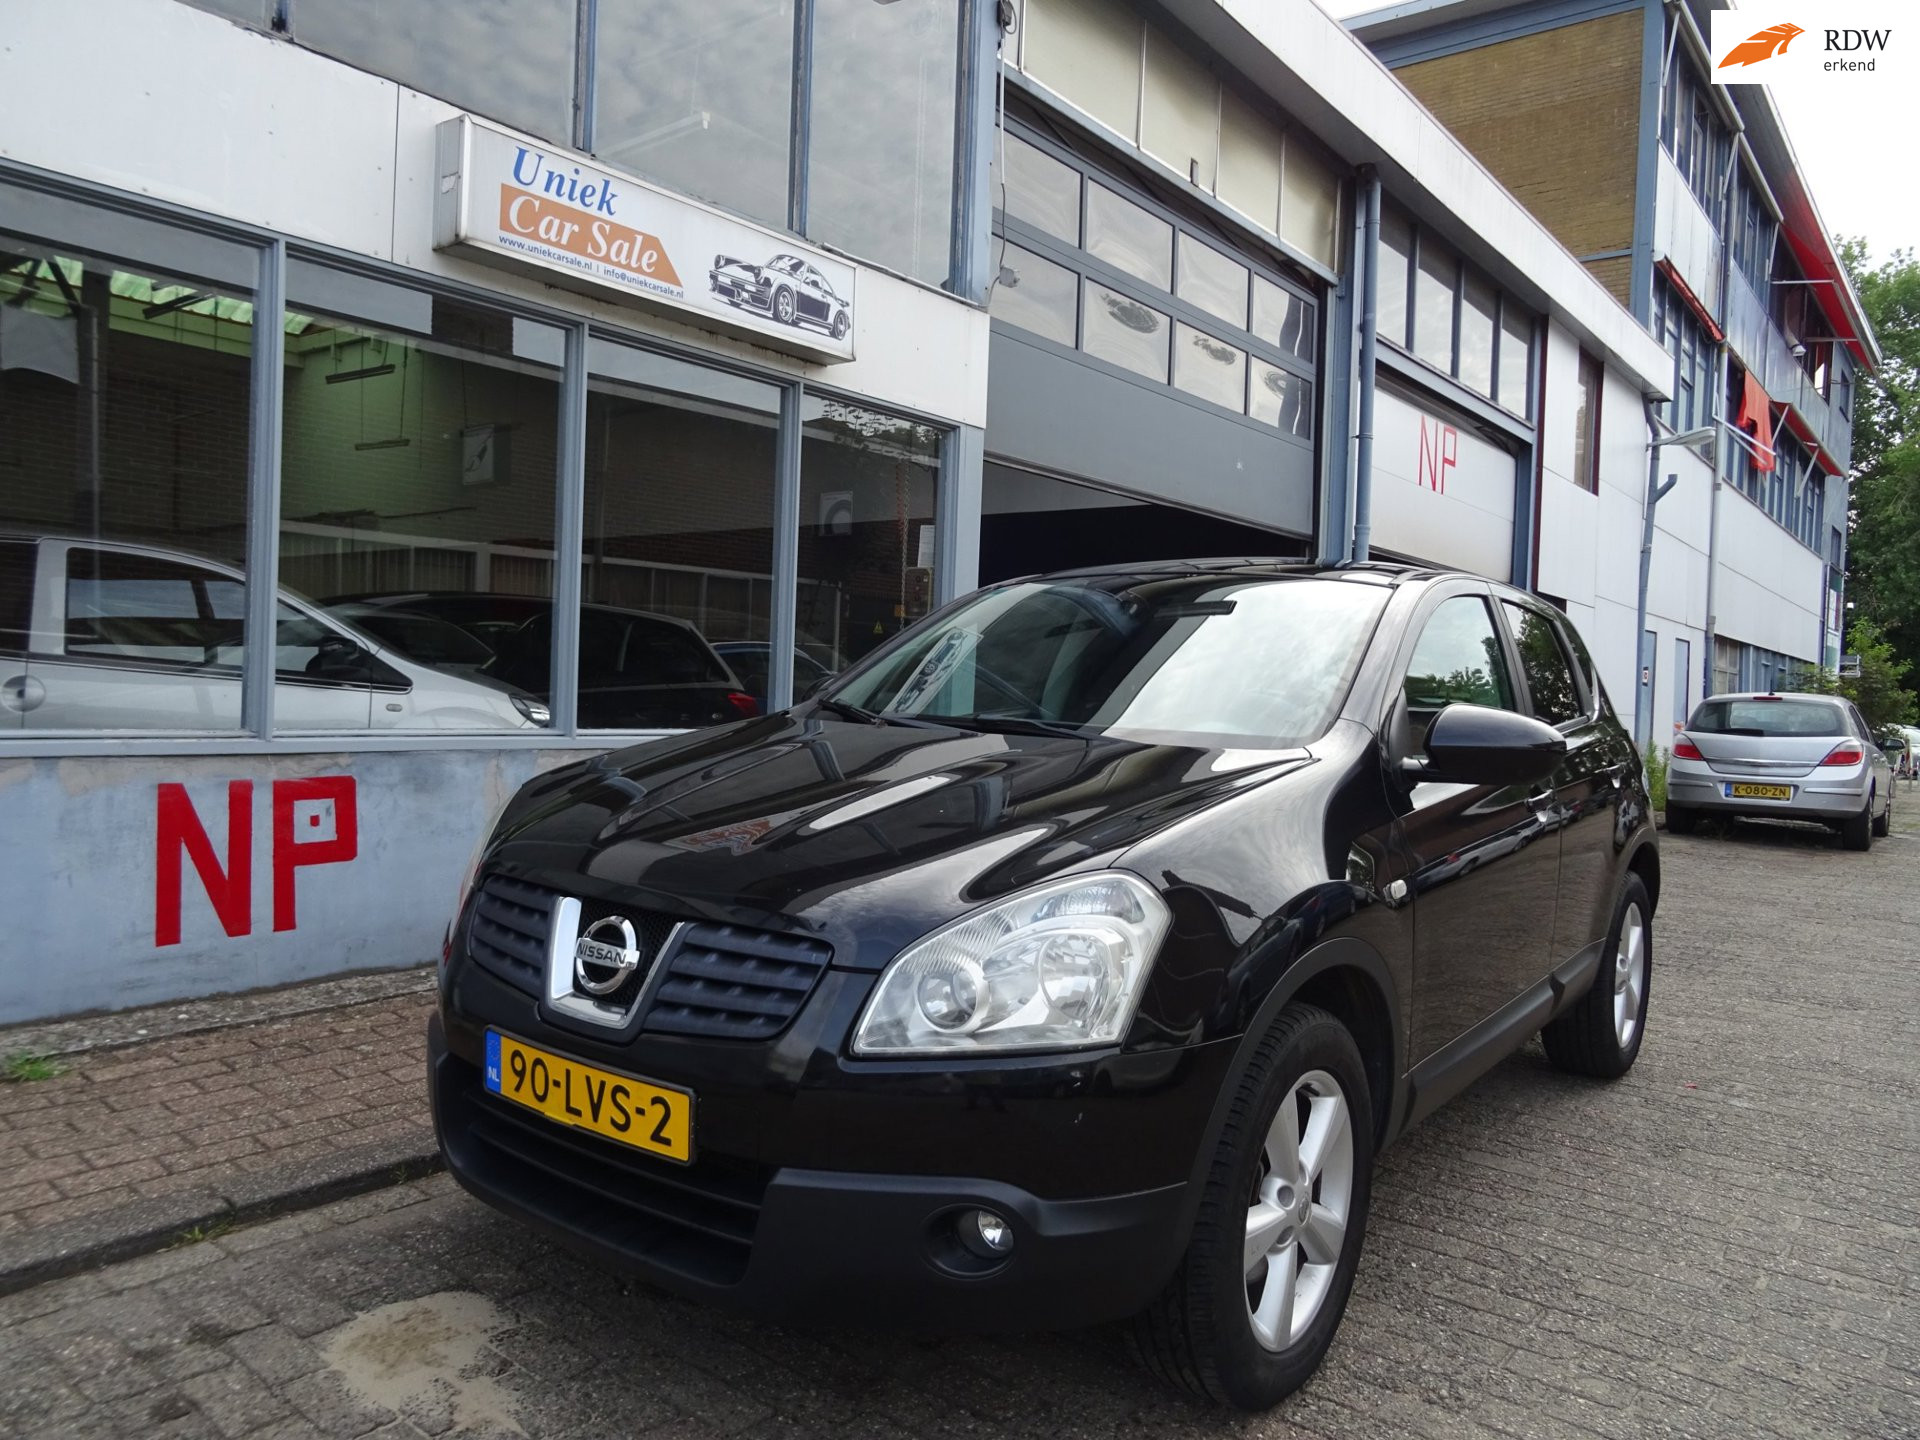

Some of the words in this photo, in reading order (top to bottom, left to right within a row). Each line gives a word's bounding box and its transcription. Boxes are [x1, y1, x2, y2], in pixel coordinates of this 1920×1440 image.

[512, 146, 619, 217] Uniek
[499, 235, 593, 271] www.uniekcarsale.nl
[603, 267, 684, 299] info@uniekcarsale.nl
[508, 195, 580, 246] Car
[587, 220, 659, 273] Sale
[1418, 415, 1457, 495] NP
[1734, 784, 1787, 796] K-080-ZN
[155, 775, 358, 947] NP
[576, 942, 627, 964] NISSAN
[488, 1066, 500, 1082] NL
[510, 1049, 672, 1147] 90-LVS-2
